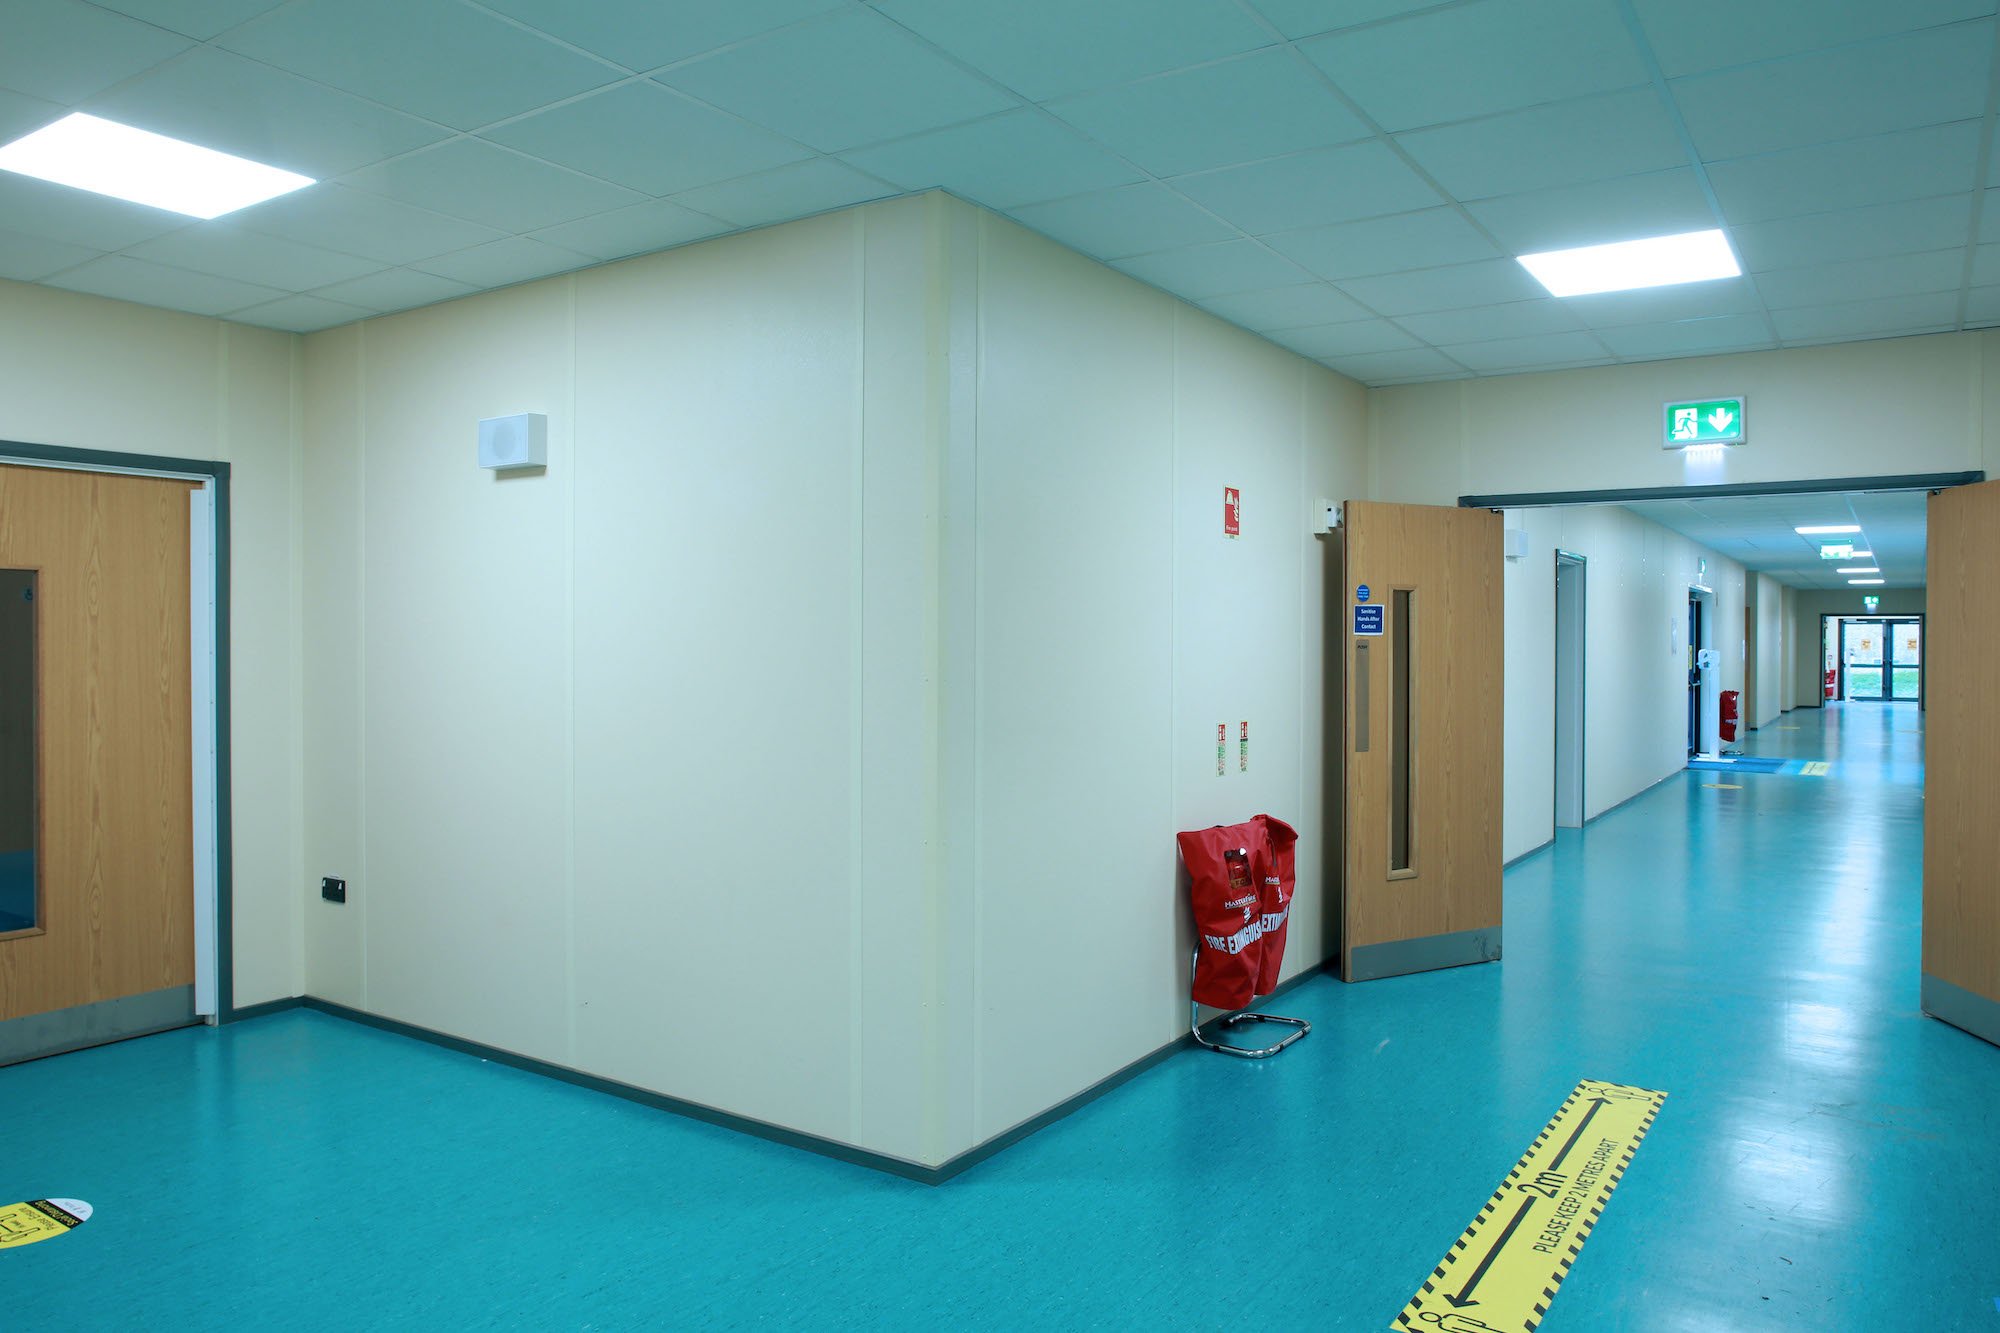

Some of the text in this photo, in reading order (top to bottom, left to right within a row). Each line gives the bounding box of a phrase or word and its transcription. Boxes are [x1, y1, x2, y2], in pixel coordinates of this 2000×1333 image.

[1204, 934, 1228, 953] FIRE
[1516, 1171, 1568, 1199] 2m
[1532, 1137, 1619, 1254] PLEASE KEEP 2 METRES APART
